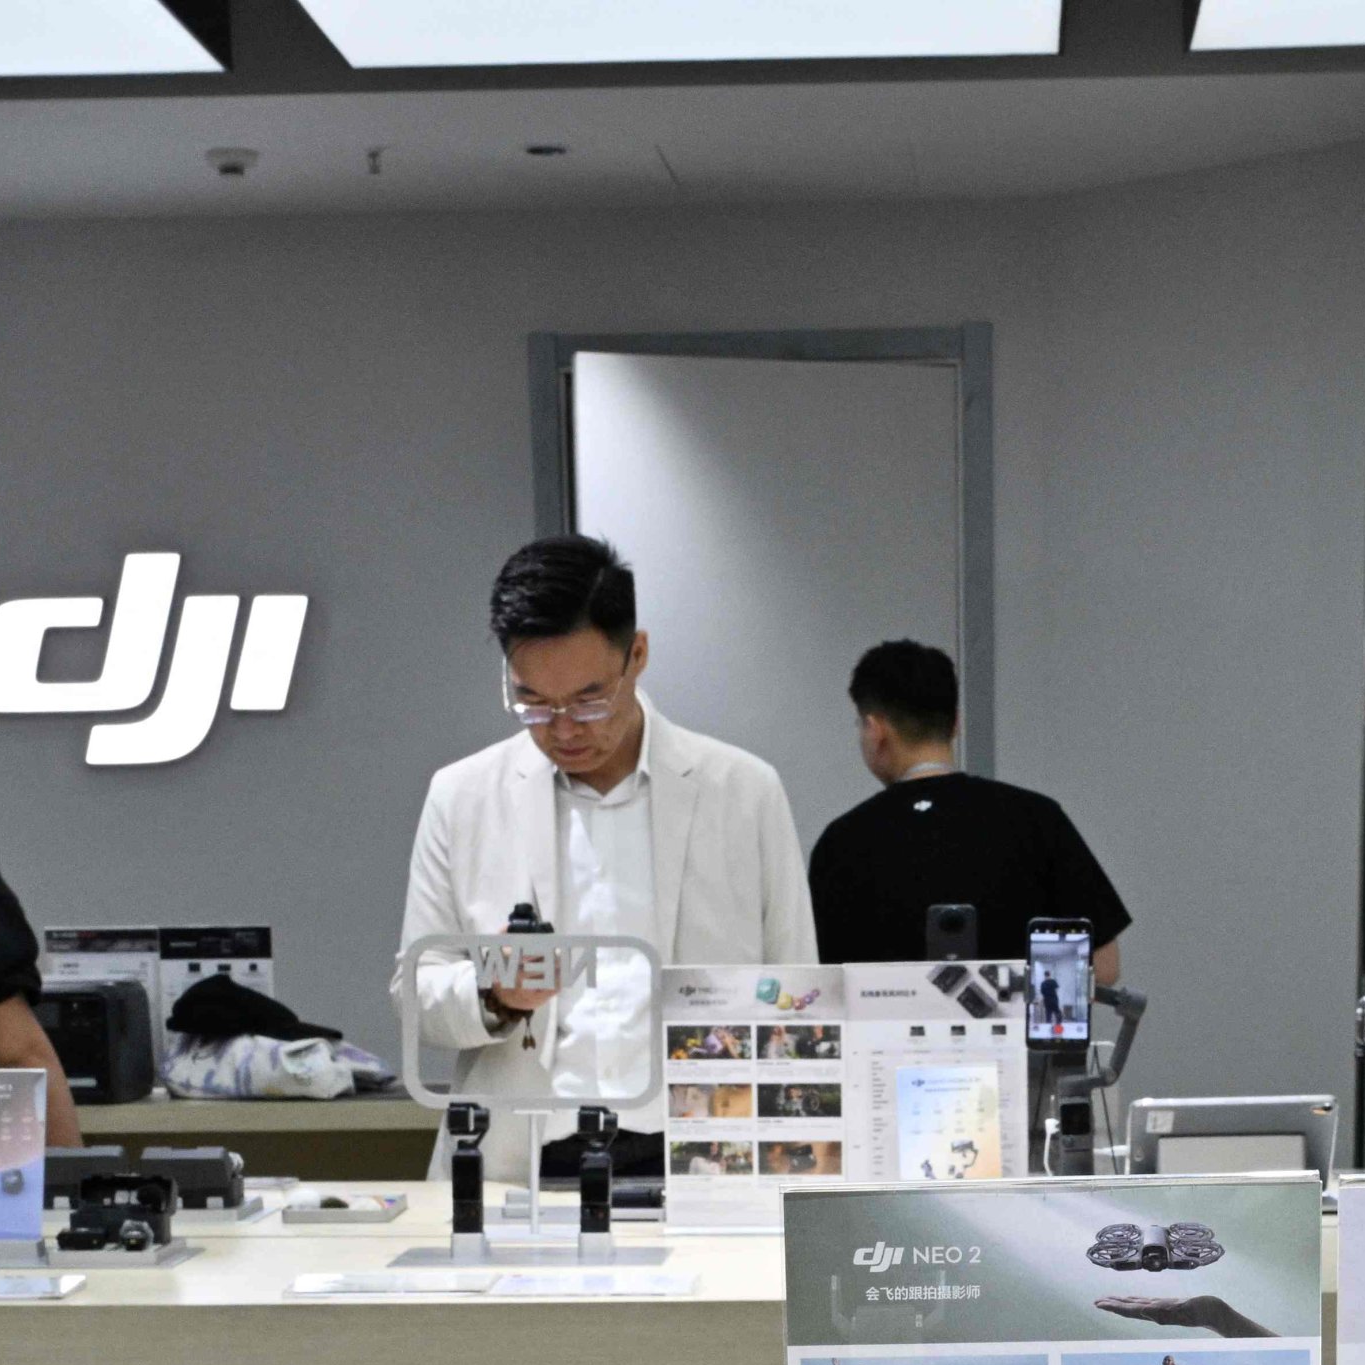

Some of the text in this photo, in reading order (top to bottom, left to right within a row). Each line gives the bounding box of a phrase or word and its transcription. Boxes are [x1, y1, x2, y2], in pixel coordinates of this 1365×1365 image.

[913, 1246, 962, 1265] NEO
[969, 1245, 982, 1264] 2
[865, 1284, 981, 1301] 会飞的跟拍摄影师
